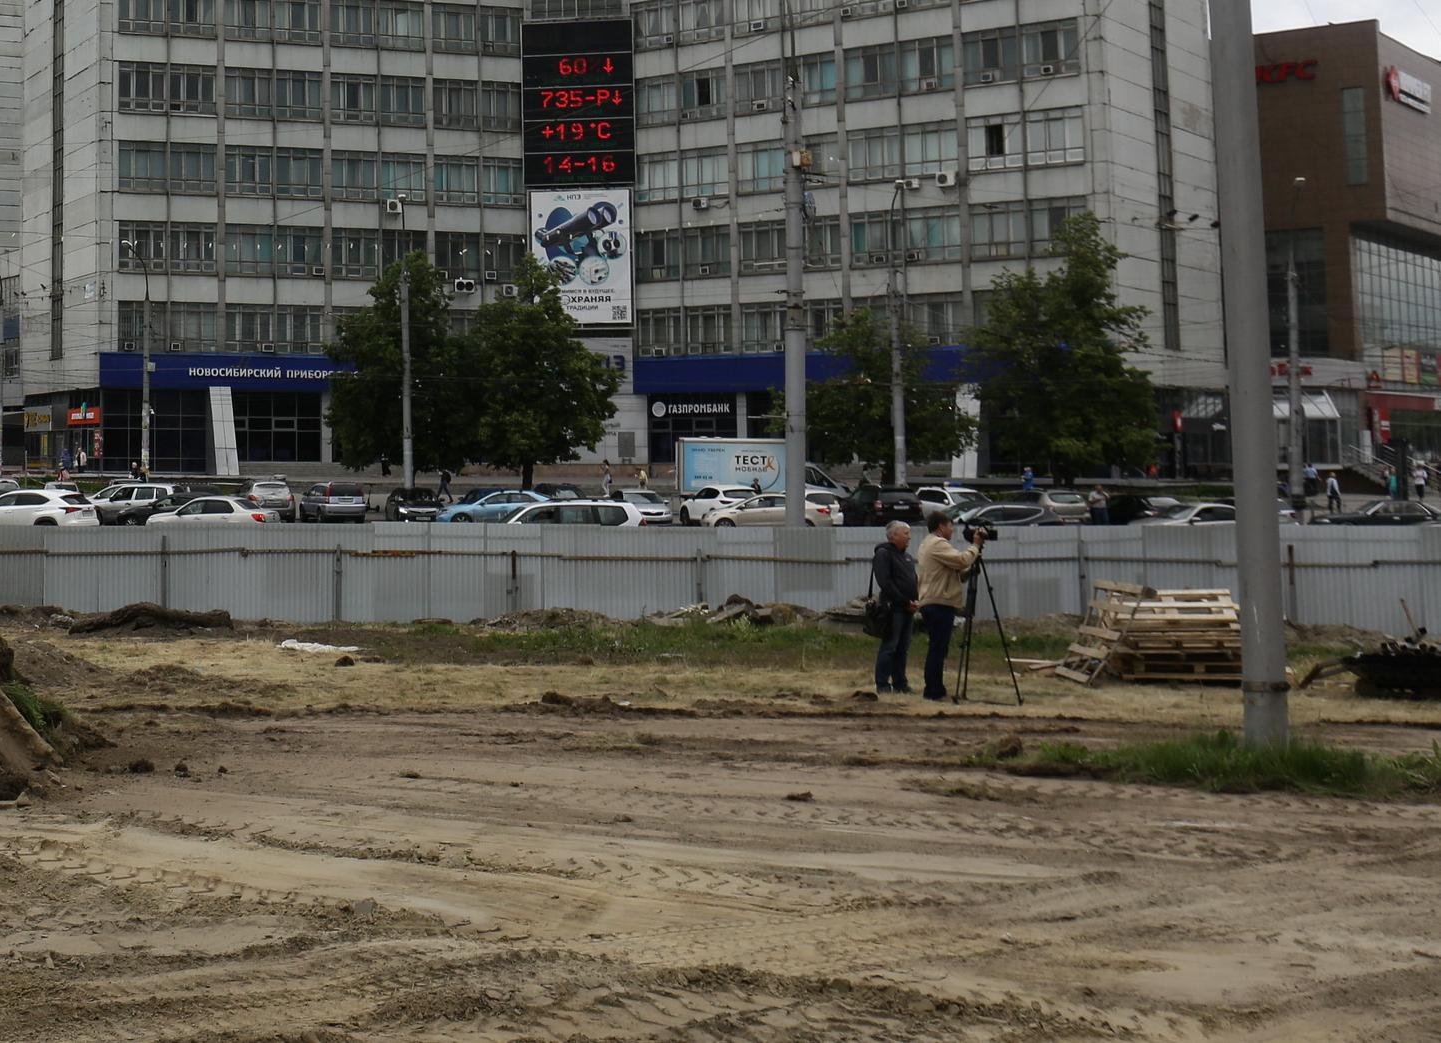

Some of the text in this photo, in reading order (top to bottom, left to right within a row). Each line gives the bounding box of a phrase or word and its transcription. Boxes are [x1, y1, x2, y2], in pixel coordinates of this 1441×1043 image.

[1256, 60, 1318, 82] KFC
[544, 155, 615, 173] 14-16
[188, 367, 281, 379] НОВОСИБИРСКИЙ
[668, 403, 730, 414] ГАЗПРОМБАНК
[735, 456, 767, 465] ТЕСТ
